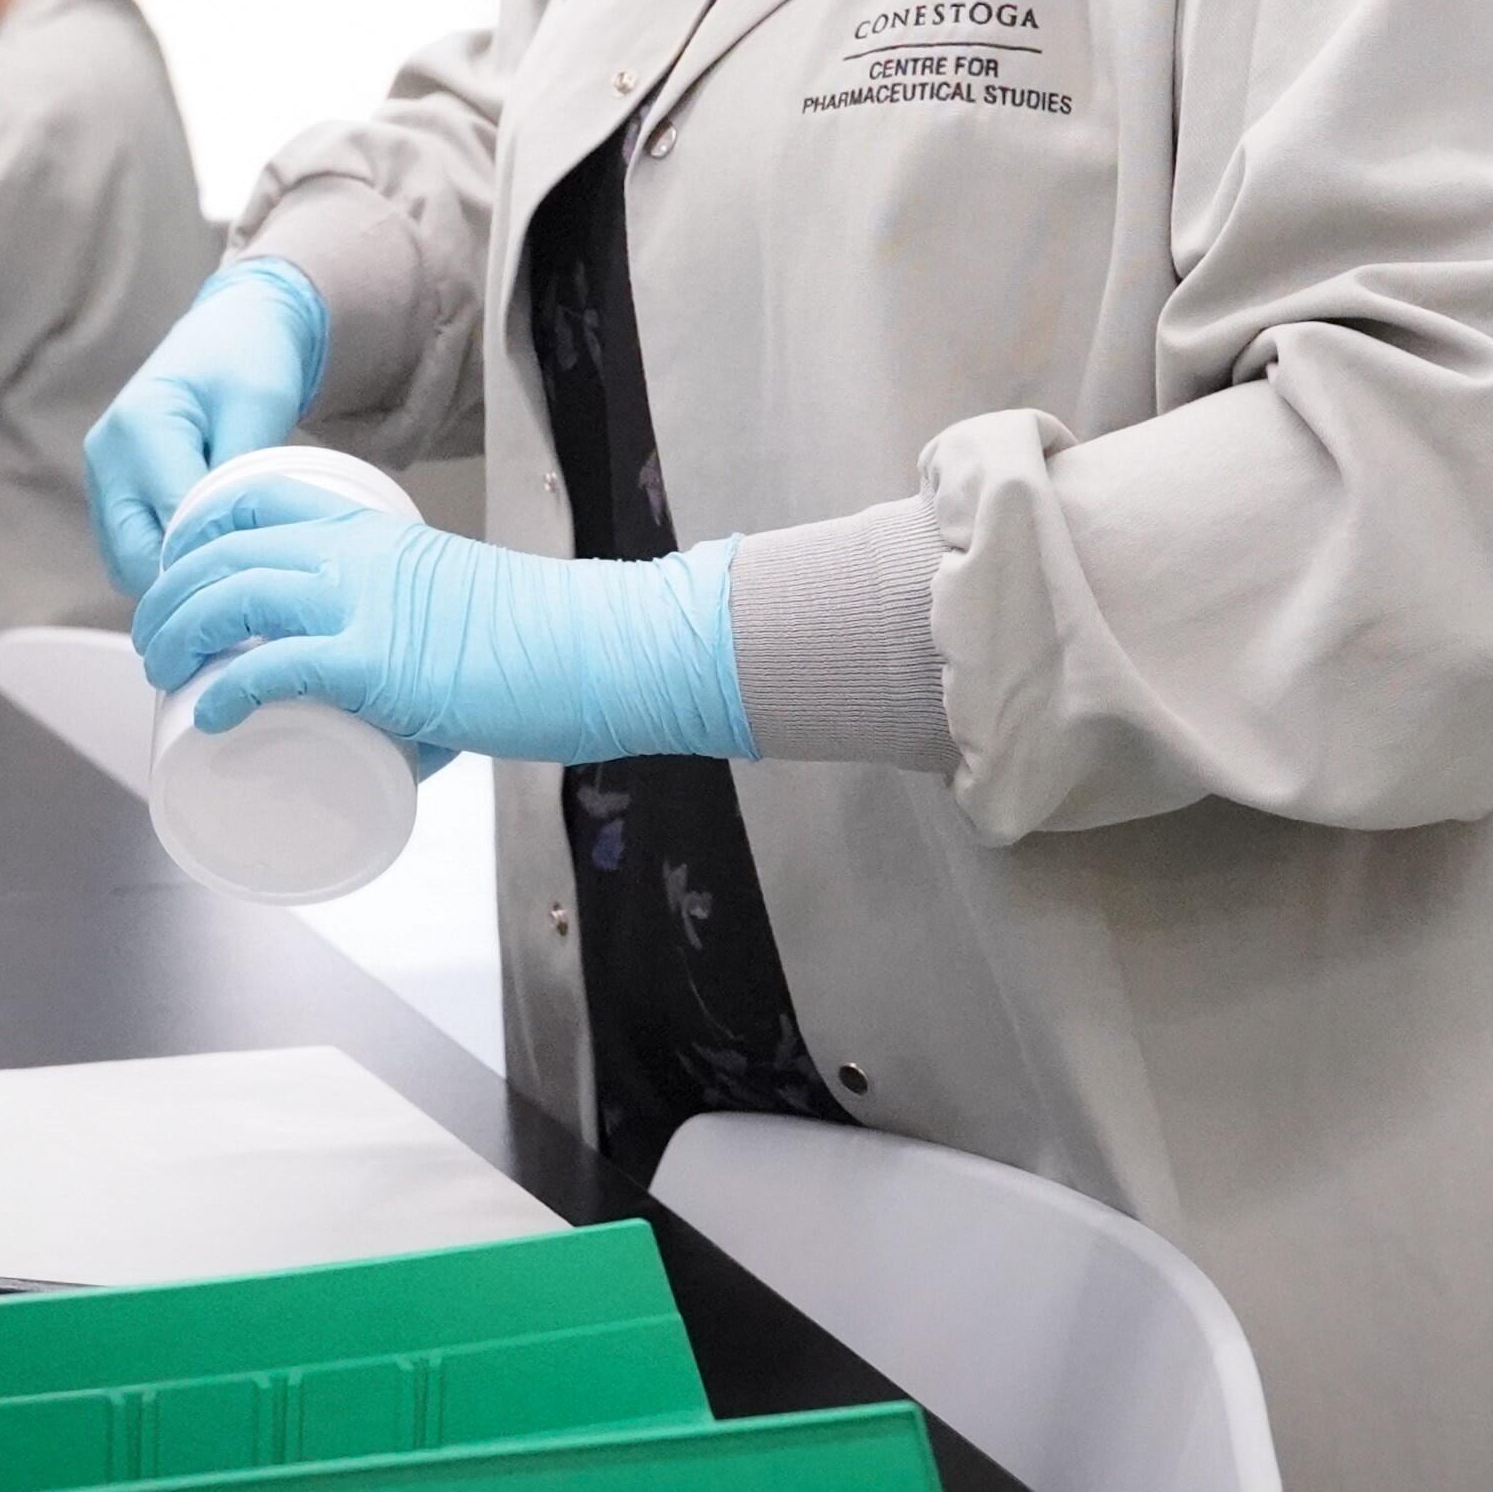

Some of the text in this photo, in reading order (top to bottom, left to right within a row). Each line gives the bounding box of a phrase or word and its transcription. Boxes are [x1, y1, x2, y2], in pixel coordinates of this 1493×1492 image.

[853, 1, 1040, 41] CONESTOGA
[868, 56, 999, 80] CENTRE FOR
[801, 81, 1073, 116] PHARMACEUTICAL STUDIES
